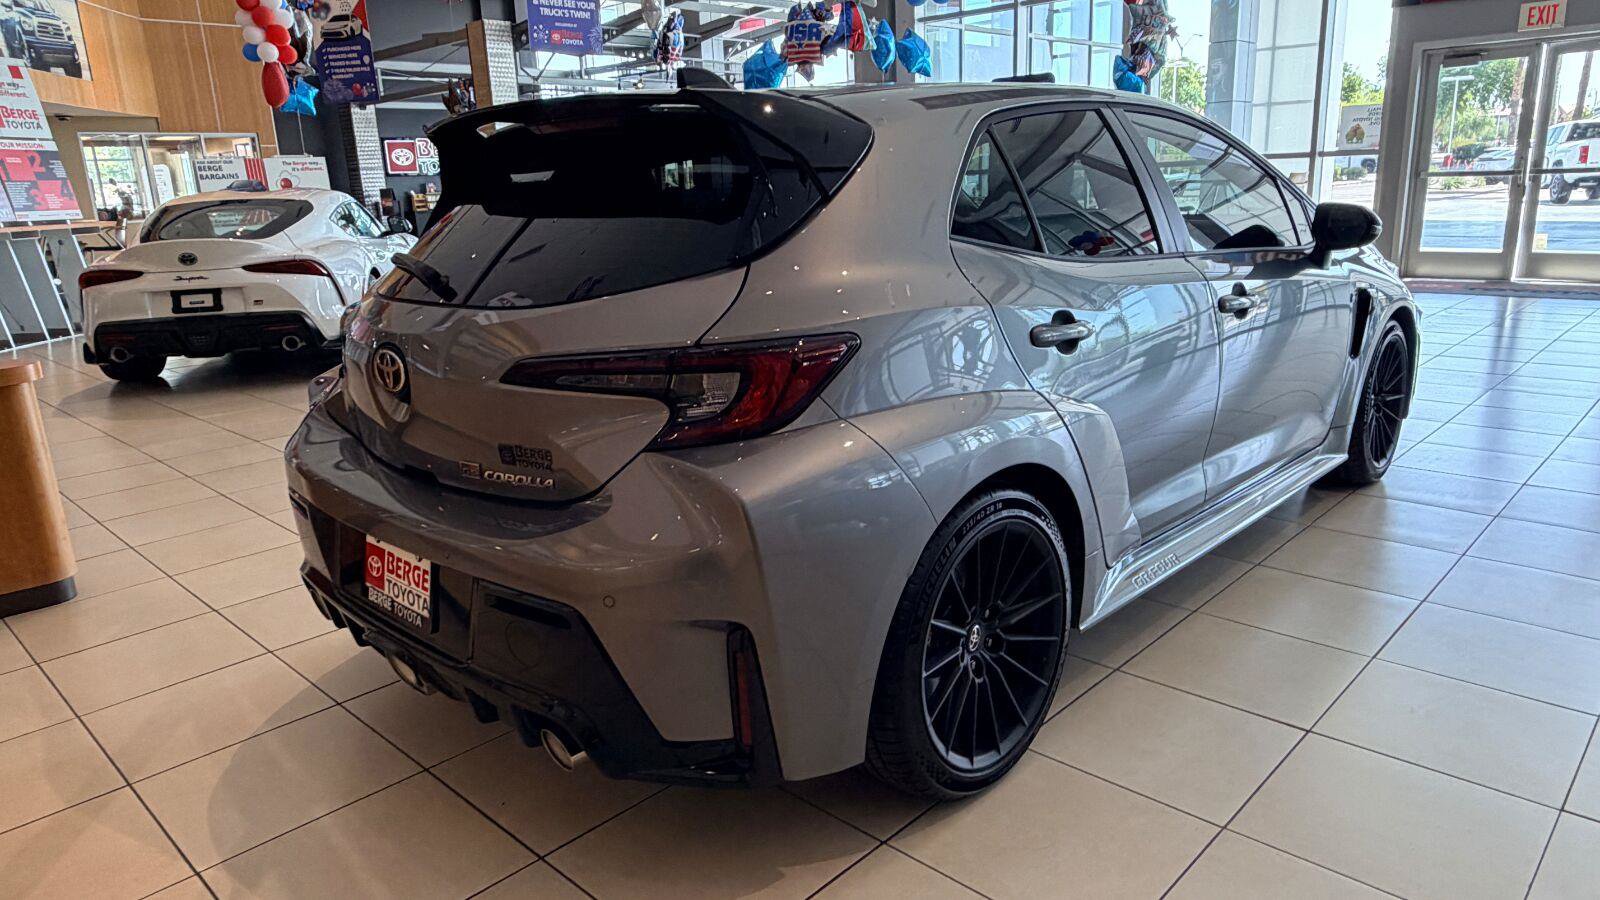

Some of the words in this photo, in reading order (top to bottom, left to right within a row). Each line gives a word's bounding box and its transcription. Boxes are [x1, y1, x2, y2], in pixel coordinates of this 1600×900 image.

[540, 7, 569, 17] TRUCK'S
[571, 10, 591, 19] TWIN!
[564, 0, 575, 8] SEE
[577, 1, 596, 10] YOUR
[1527, 4, 1559, 26] EXIT
[785, 23, 822, 41] USA
[562, 38, 584, 46] TOYOTA
[0, 105, 40, 120] BERGE
[6, 120, 43, 130] TOYOTA
[199, 172, 239, 180] BARGAINS
[514, 444, 552, 462] BERGE
[484, 470, 555, 488] COROLLA
[386, 550, 429, 593] BERGE
[386, 579, 429, 612] TOYOTA
[368, 587, 393, 611] BERGE
[394, 601, 422, 627] TOYOTA
